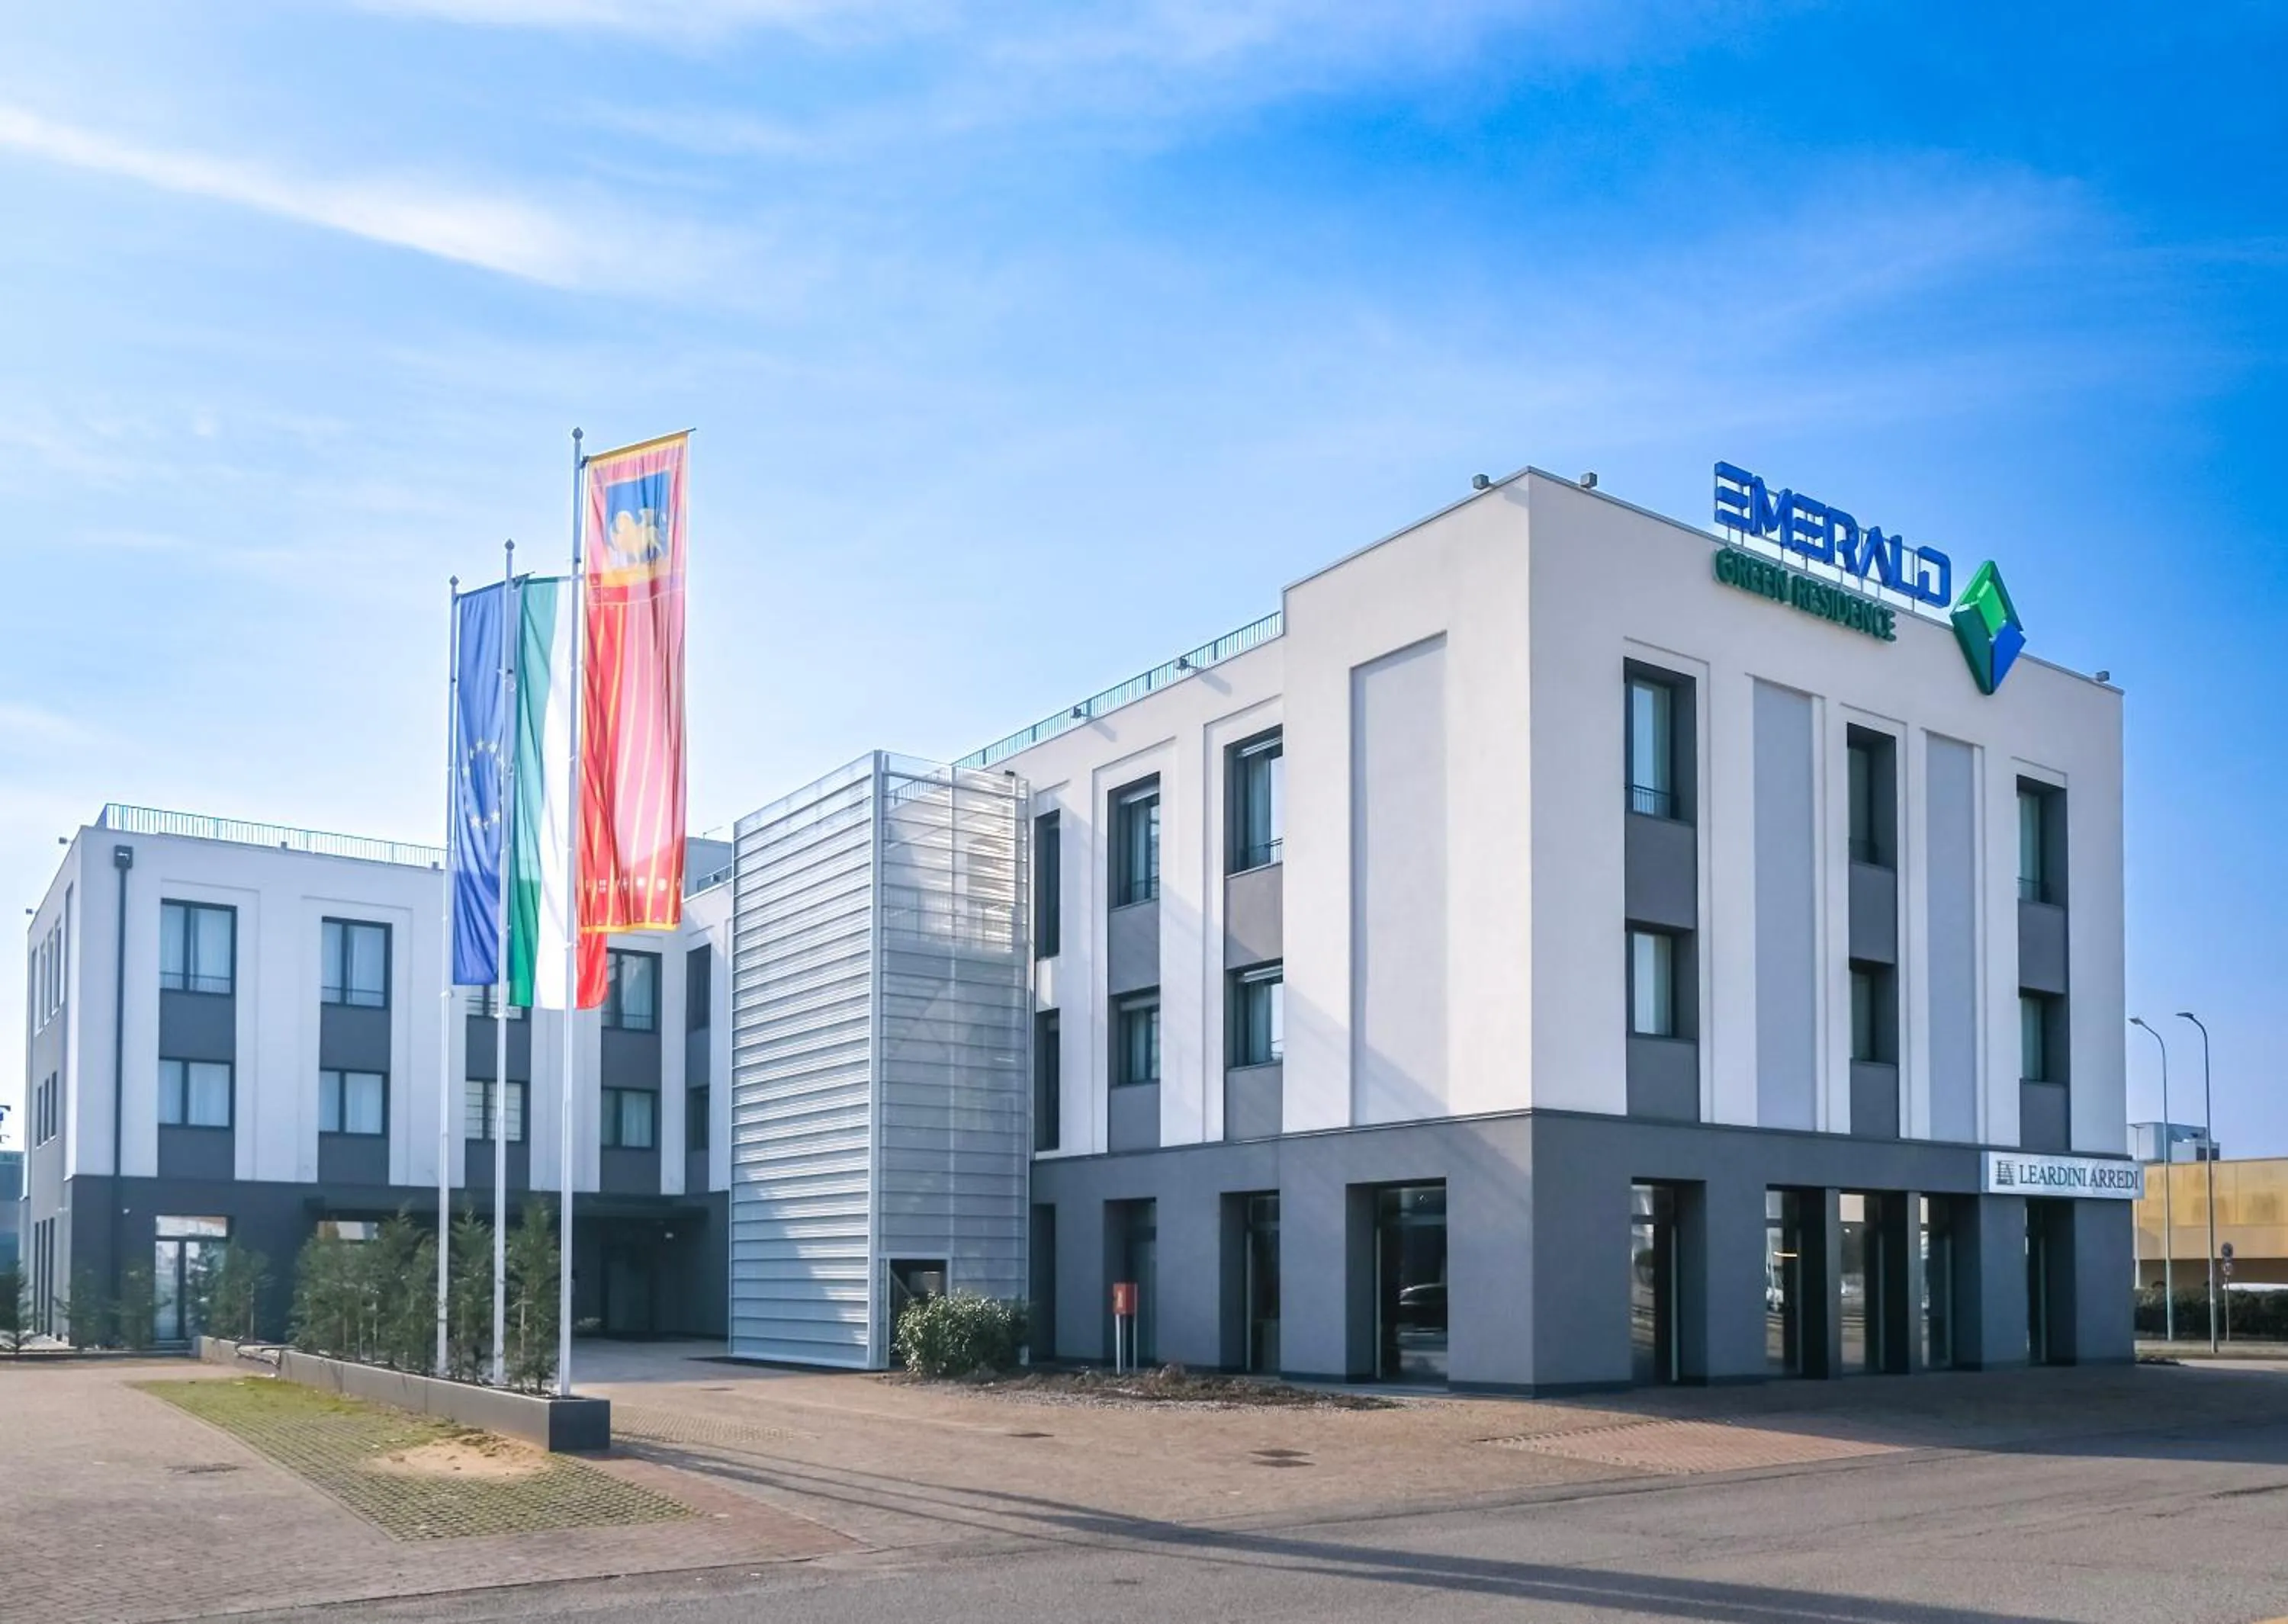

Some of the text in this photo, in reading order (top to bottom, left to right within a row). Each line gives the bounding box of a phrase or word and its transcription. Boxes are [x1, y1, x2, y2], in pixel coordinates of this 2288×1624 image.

[1714, 461, 1951, 608] EMERALD
[1714, 547, 1897, 641] GREEN RESIDENCE
[2020, 1164, 2139, 1190] LEARDINI ARREDI
